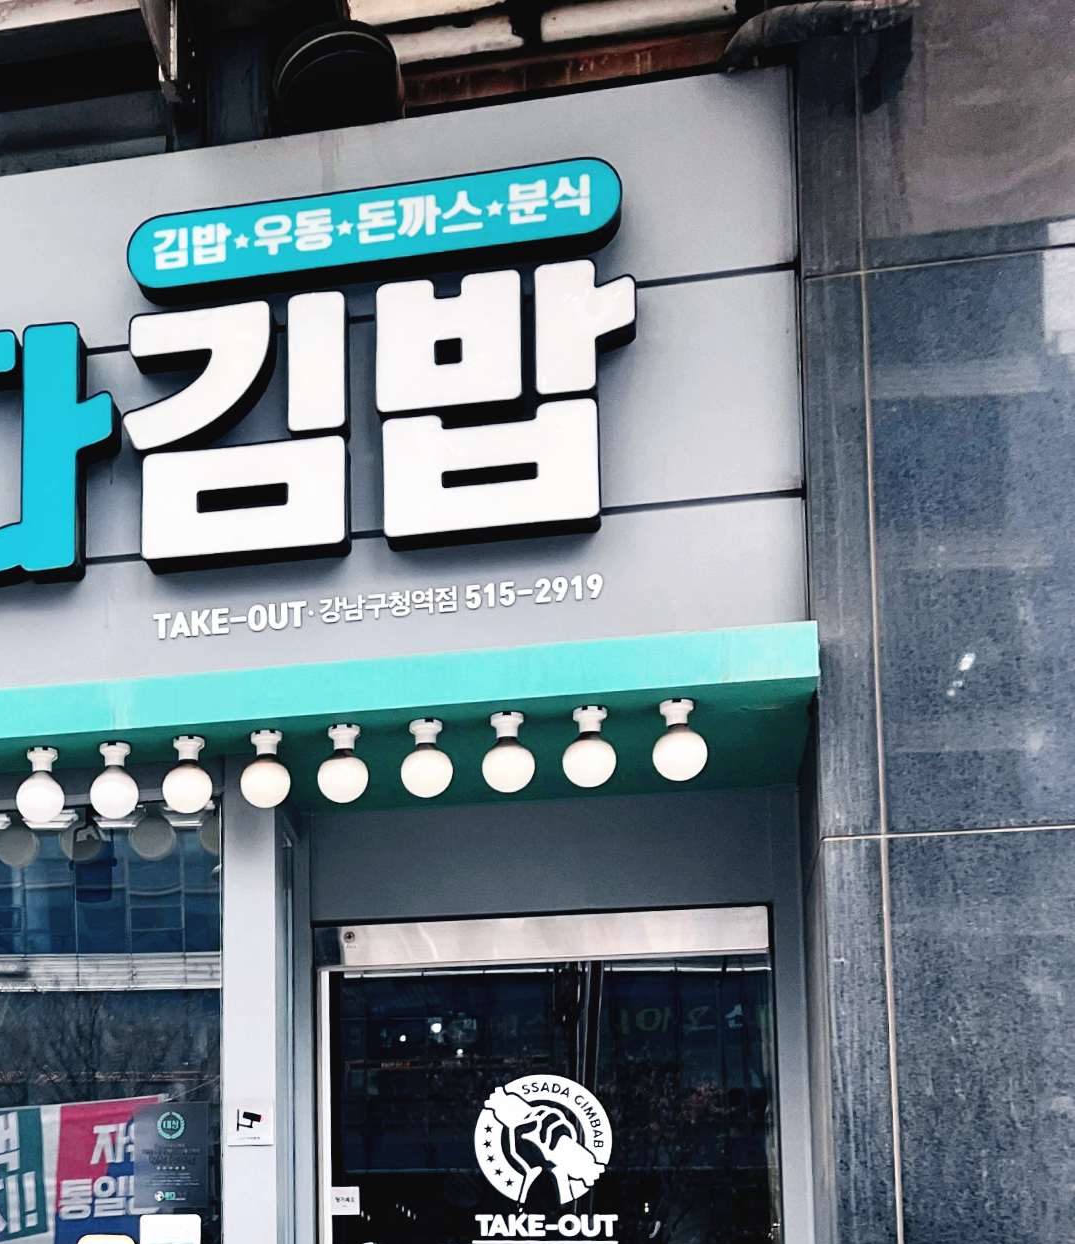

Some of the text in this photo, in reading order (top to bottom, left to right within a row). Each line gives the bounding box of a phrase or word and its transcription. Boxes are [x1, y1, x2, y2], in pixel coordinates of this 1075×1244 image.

[153, 173, 591, 270] 김밥 우동 돈까스 분식
[319, 585, 458, 624] 강남구청역점
[465, 572, 604, 611] 515-2919
[521, 1082, 605, 1150] SSADA GIMBAB
[475, 1214, 619, 1238] TAKE-OUT
